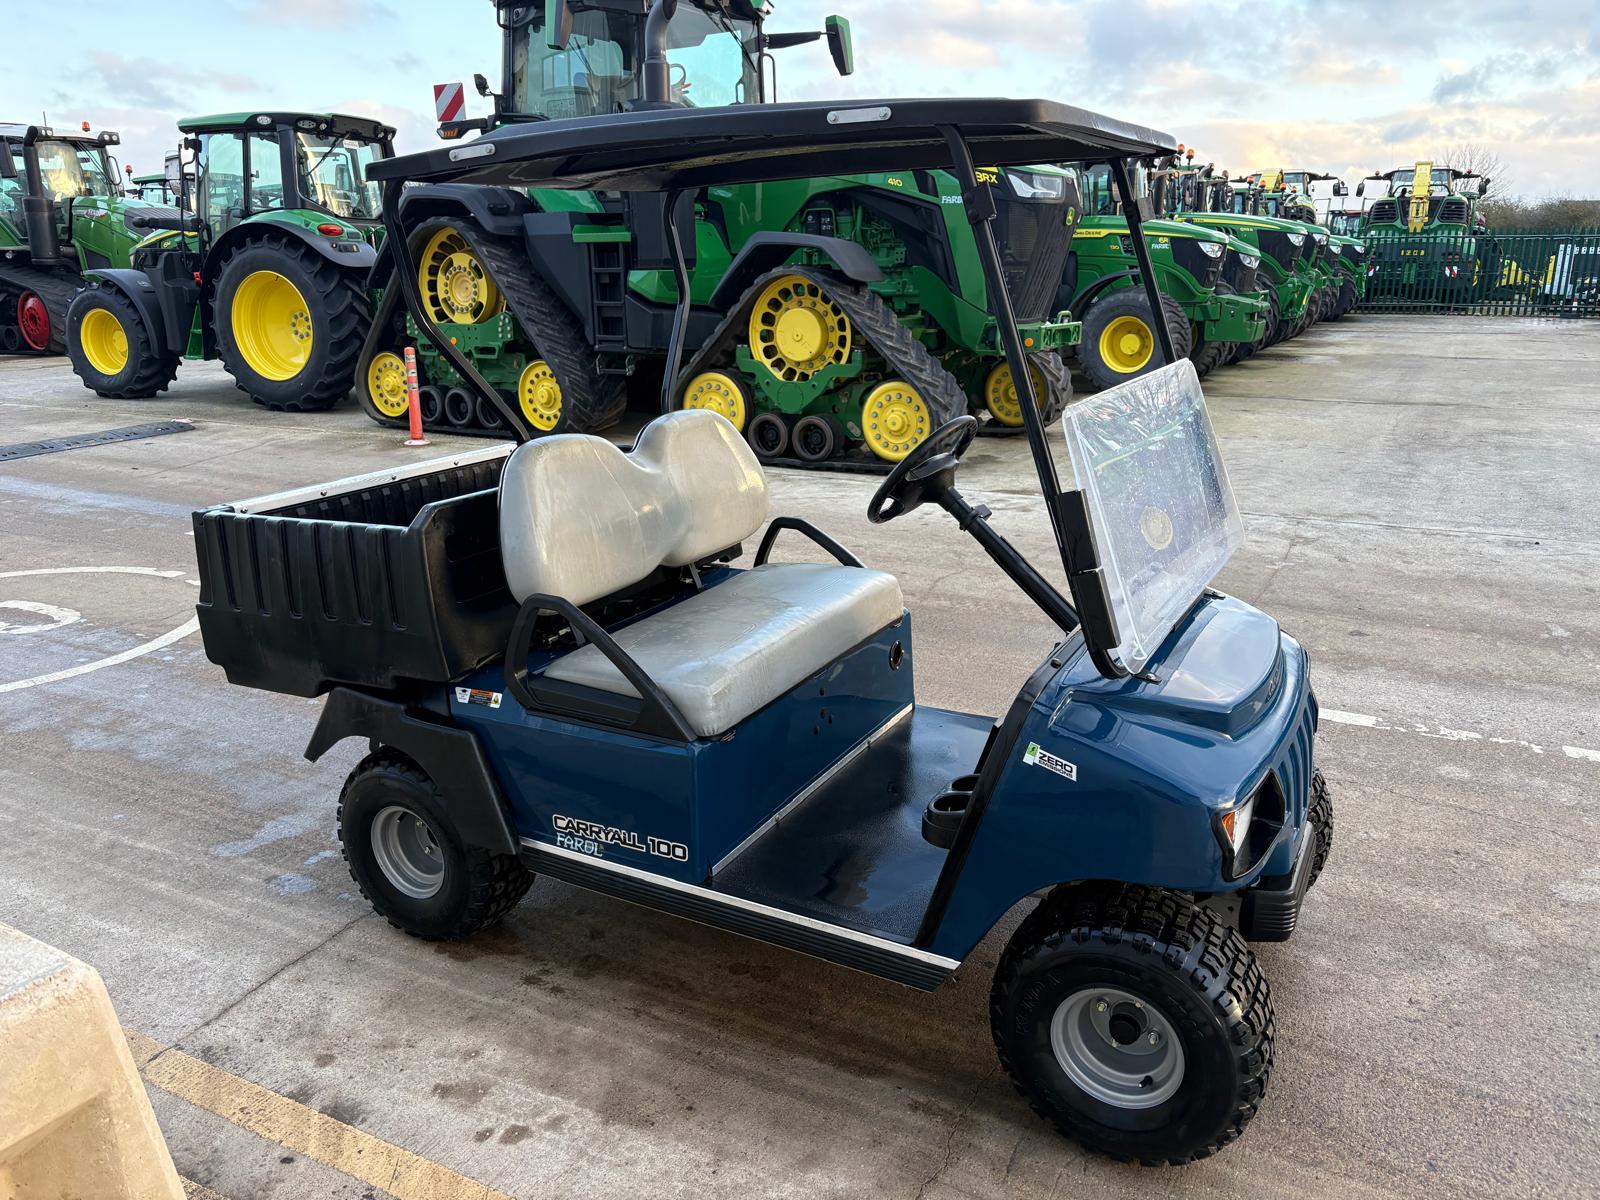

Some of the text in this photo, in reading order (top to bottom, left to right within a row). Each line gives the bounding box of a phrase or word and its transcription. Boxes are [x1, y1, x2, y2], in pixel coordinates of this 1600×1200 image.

[887, 177, 903, 187] 410
[1038, 751, 1073, 773] ZERO
[552, 814, 689, 862] CARRYALL 100
[556, 832, 603, 857] FAROL
